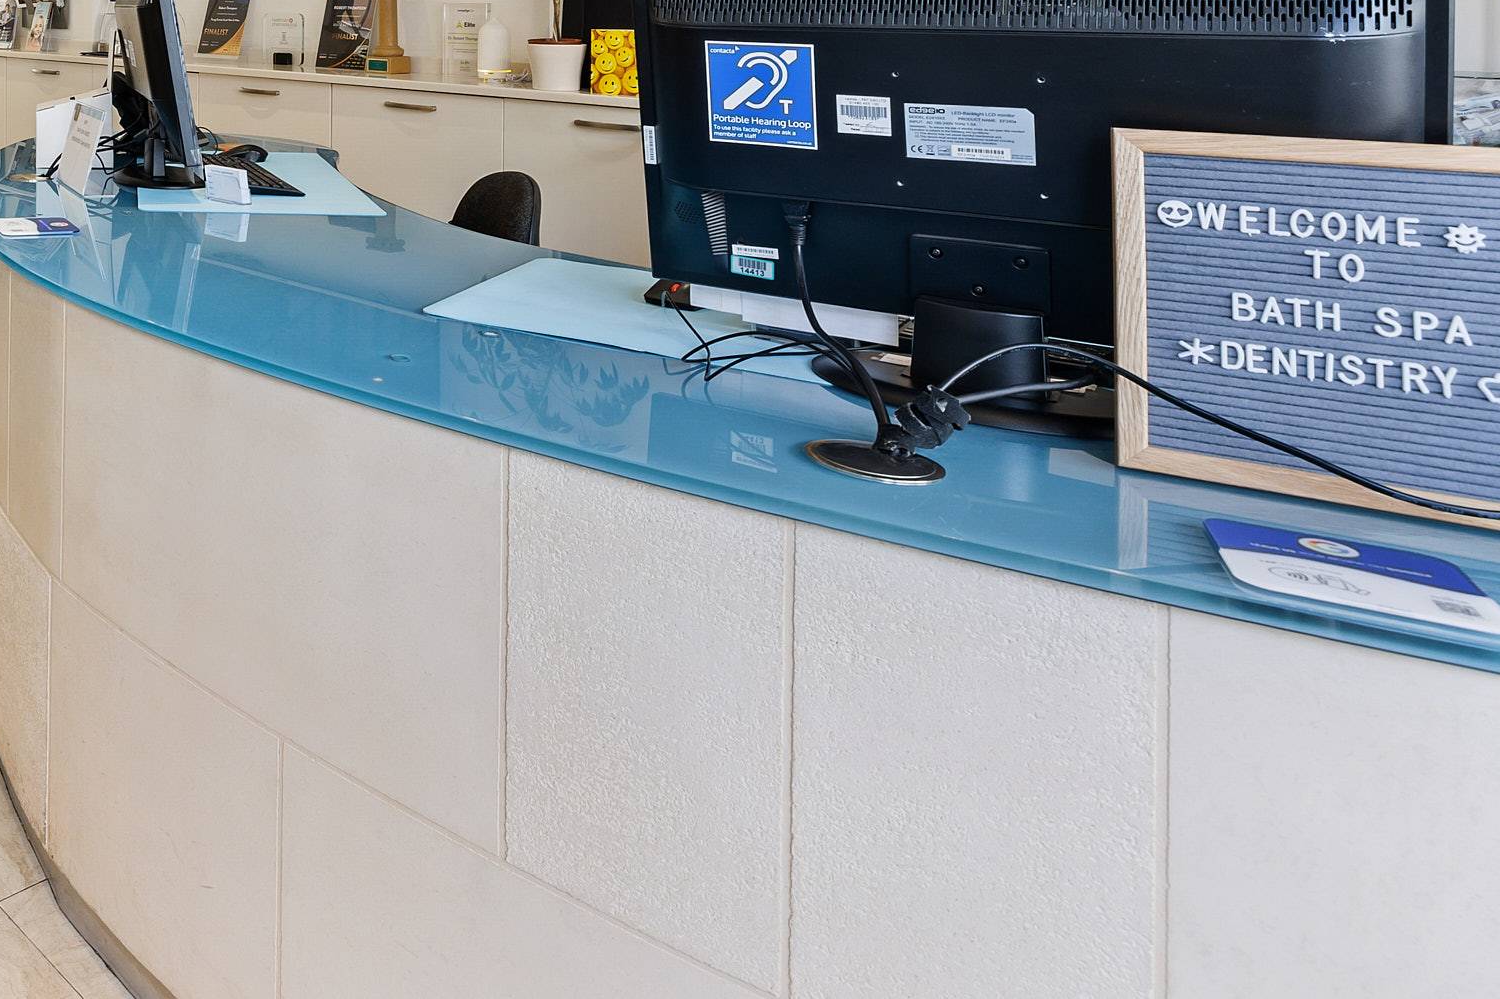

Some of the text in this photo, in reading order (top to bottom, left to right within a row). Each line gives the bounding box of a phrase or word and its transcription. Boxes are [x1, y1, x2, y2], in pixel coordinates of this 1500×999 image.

[713, 113, 811, 130] Portable Hearing Loop
[1196, 201, 1422, 248] WELCOME
[740, 267, 765, 277] 14413
[1303, 249, 1365, 283] TO
[1231, 291, 1474, 347] BATH SPA
